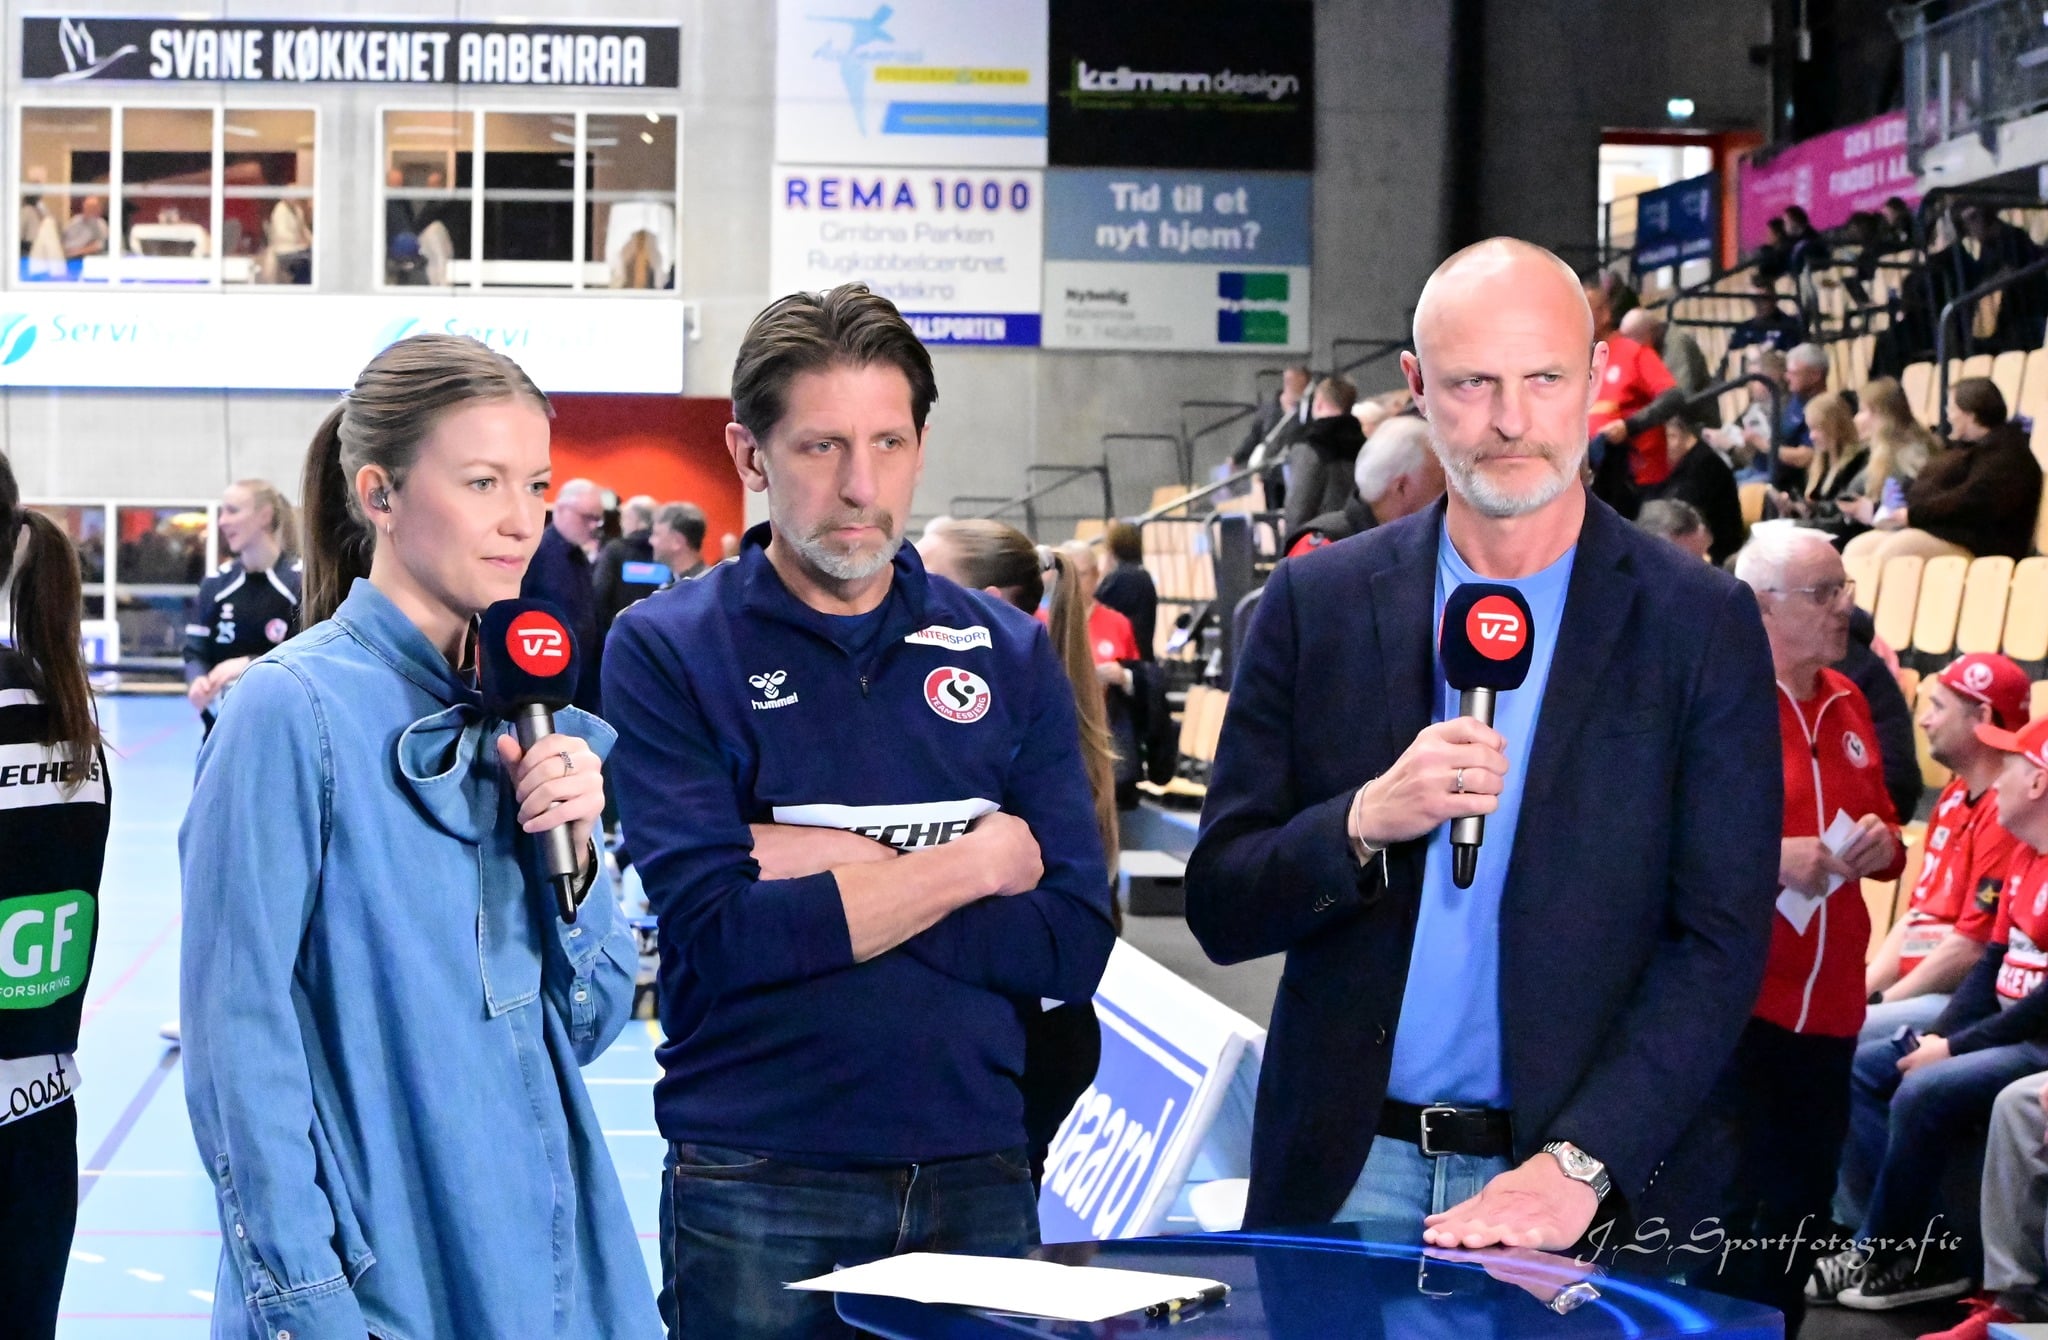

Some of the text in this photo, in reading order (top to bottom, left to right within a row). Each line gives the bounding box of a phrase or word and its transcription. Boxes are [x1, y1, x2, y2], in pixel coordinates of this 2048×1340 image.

[150, 26, 647, 86] SVANE KØKKENET AABENRAA
[1213, 67, 1299, 101] design
[786, 178, 1029, 211] REMA 1000
[1109, 182, 1248, 215] Tid til et
[914, 221, 995, 244] Parken
[1095, 219, 1261, 253] nyt hjem?
[902, 316, 1006, 341] ALSPORTEN
[916, 629, 987, 645] INTERSPORT
[751, 692, 798, 710] hummel
[931, 696, 986, 720] TEAM ESBJERG
[0, 901, 78, 978] GF
[0, 975, 70, 998] ORSIKRNG
[0, 1053, 71, 1124] oast
